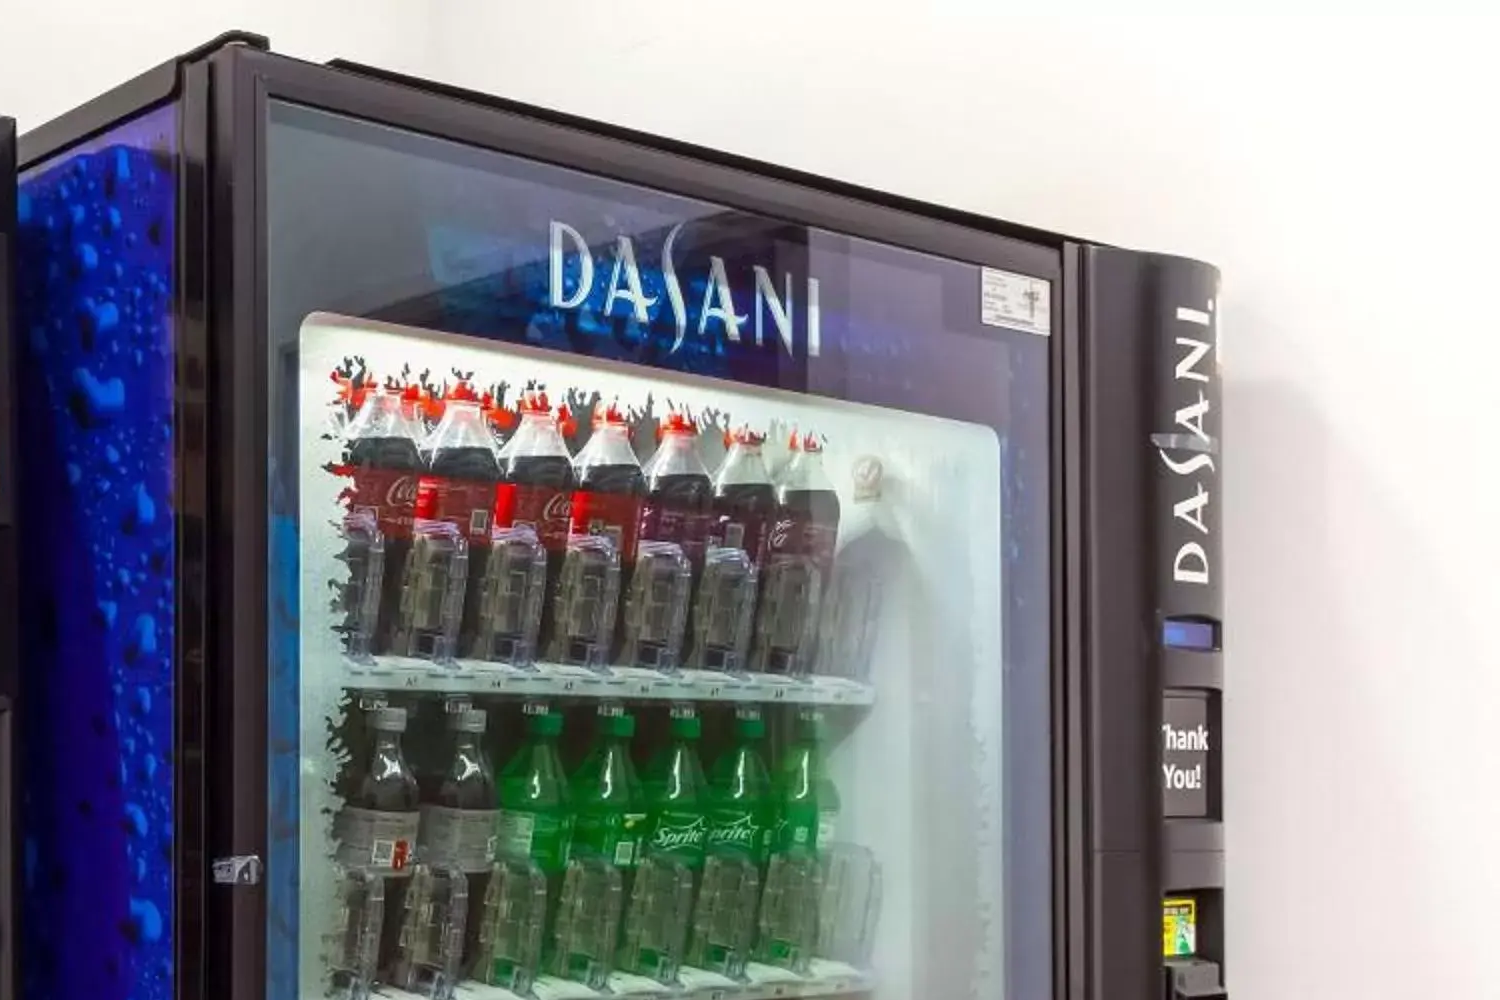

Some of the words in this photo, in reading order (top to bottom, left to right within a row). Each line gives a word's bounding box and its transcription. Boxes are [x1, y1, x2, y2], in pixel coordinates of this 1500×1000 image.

[550, 219, 820, 358] DASANI
[1158, 301, 1215, 585] DASANI
[1162, 764, 1202, 790] You!
